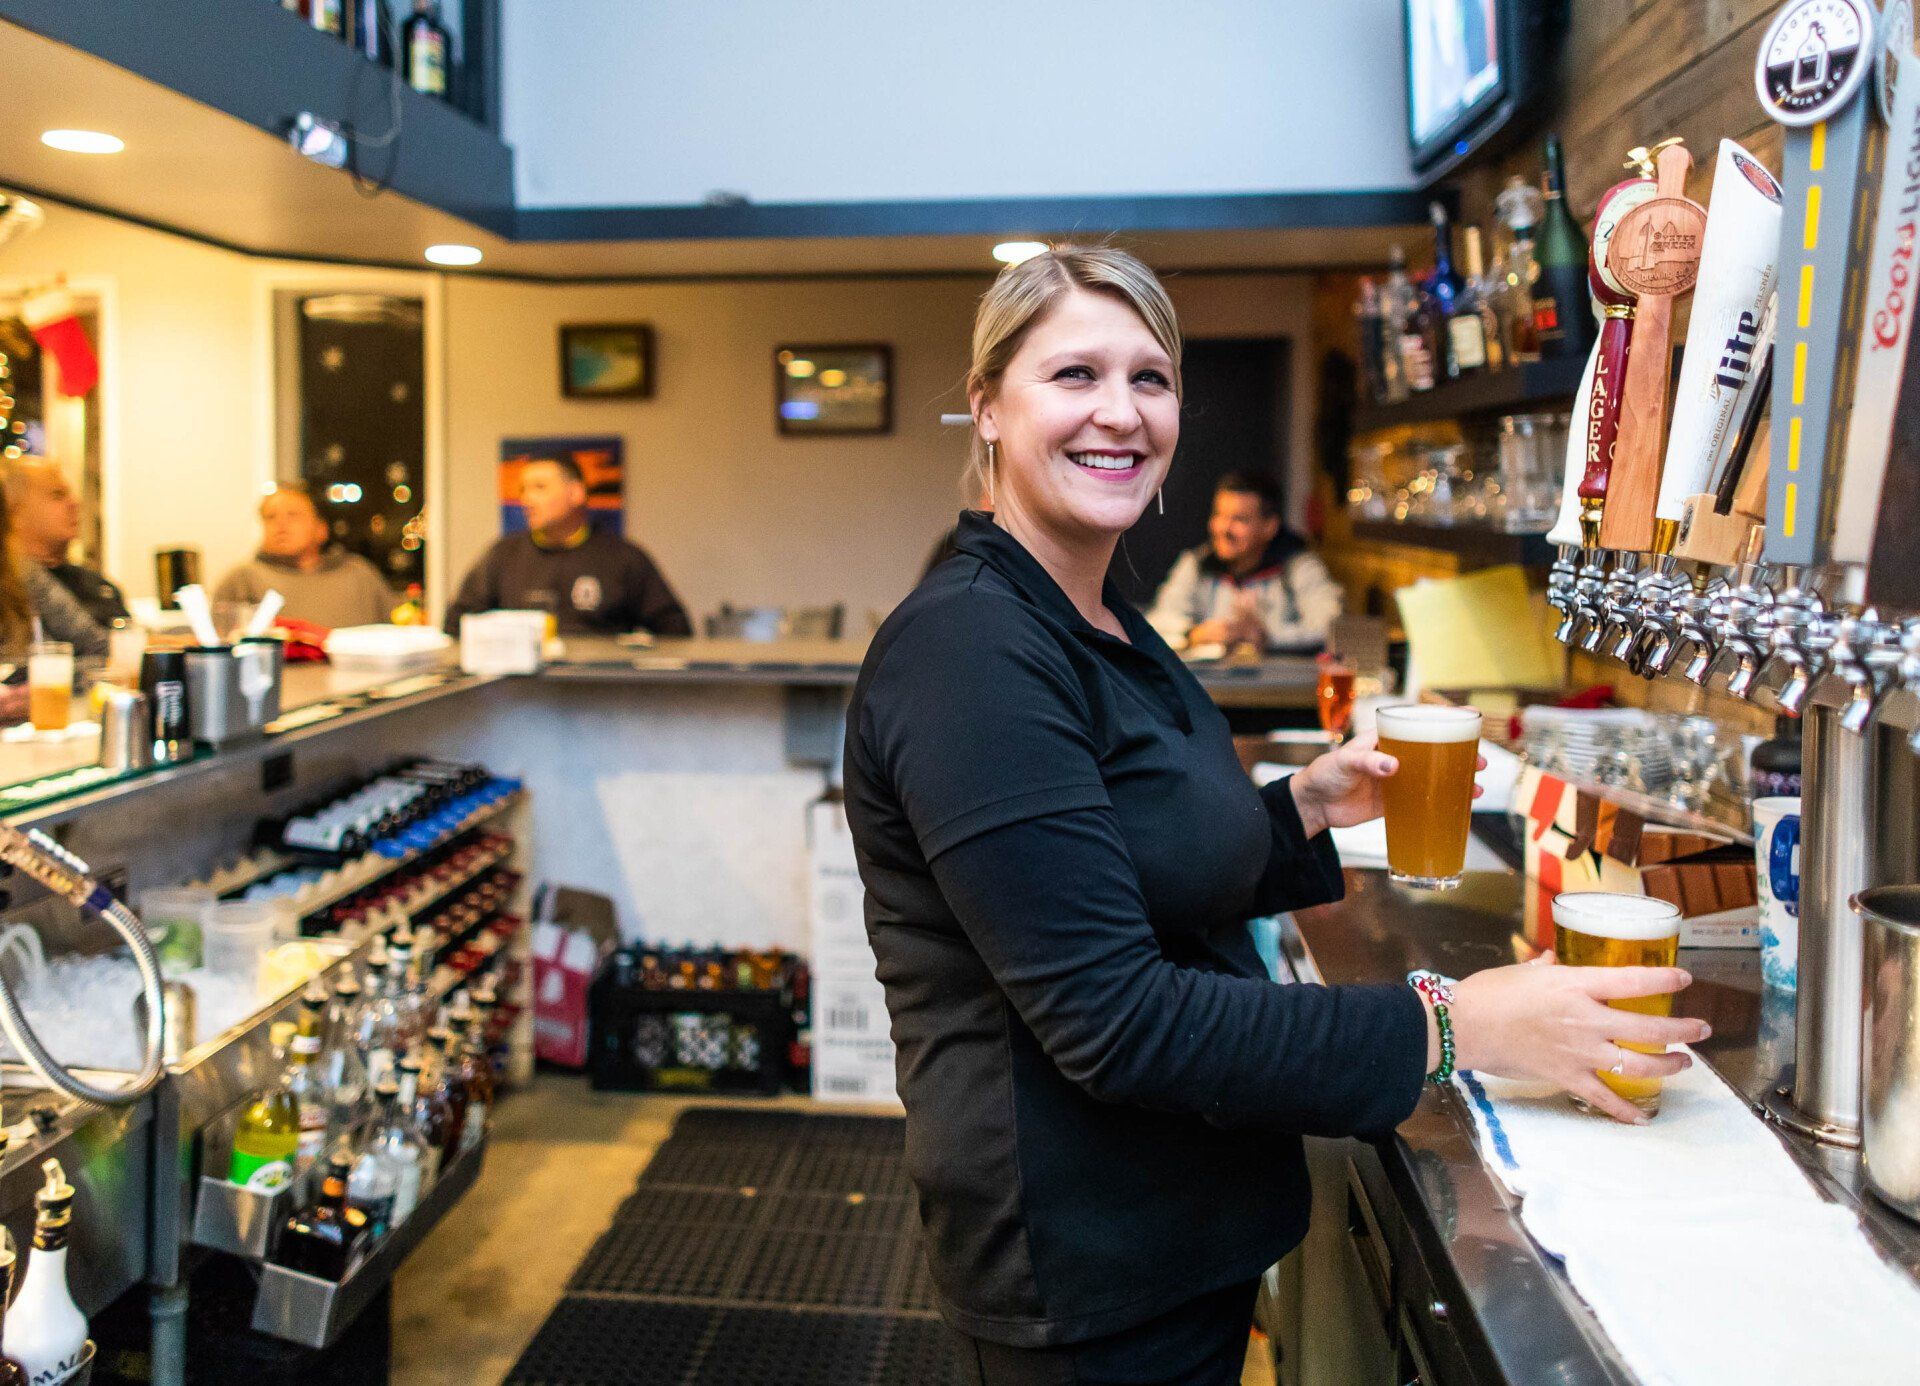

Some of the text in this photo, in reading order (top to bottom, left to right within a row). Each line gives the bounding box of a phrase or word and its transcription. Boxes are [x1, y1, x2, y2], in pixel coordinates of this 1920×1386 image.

[1775, 3, 1854, 56] JUGHANDLE
[1587, 354, 1609, 463] LAGER
[1712, 398, 1733, 447] ORIGINAL
[1753, 264, 1773, 310] PILSNER
